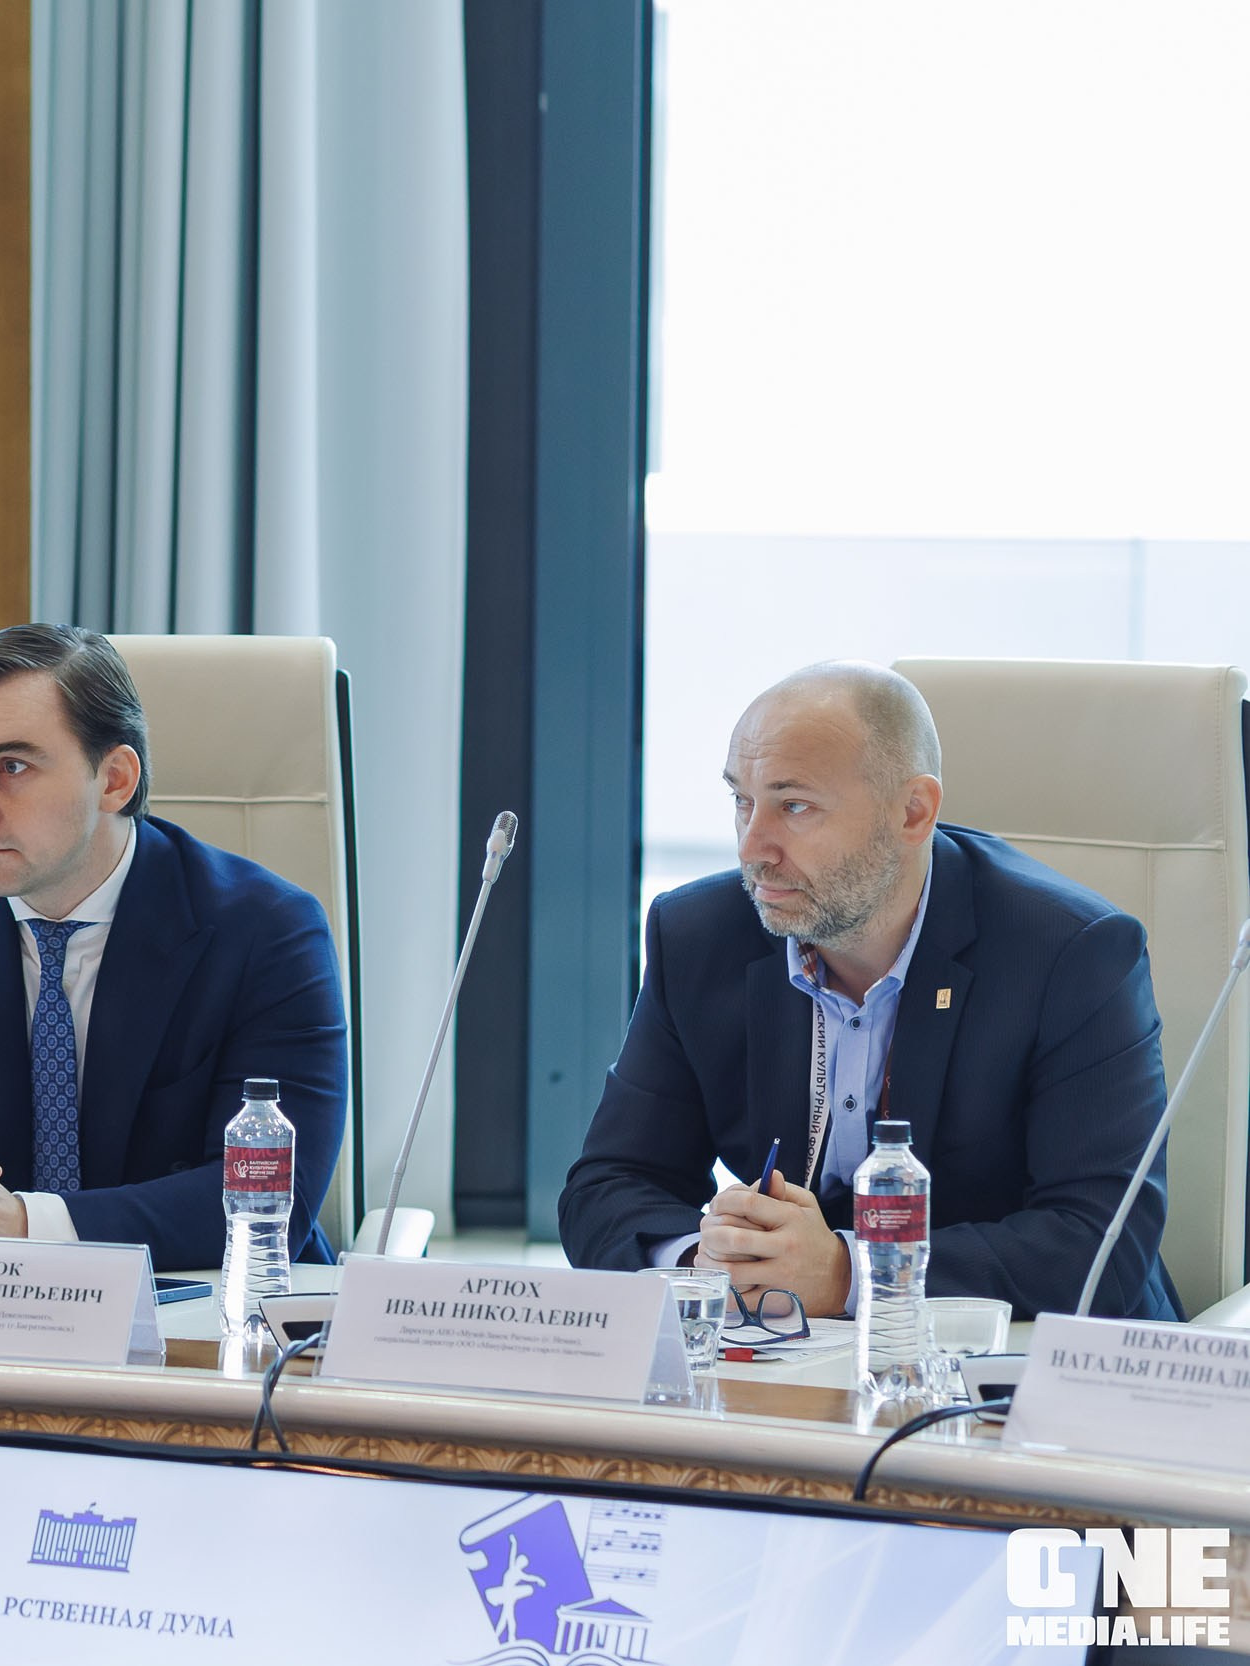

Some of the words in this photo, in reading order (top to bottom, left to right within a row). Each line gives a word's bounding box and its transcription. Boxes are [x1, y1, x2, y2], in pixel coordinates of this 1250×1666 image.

[811, 1051, 827, 1134] КУЛЬТУРНЫЙ
[460, 1277, 542, 1299] АРТЮХ
[385, 1299, 446, 1318] ИВАН
[452, 1303, 610, 1329] НИКОЛАЕВИЧ
[1122, 1329, 1250, 1360] НЕКРАСОВА
[1051, 1349, 1150, 1377] НАТАЛЬЯ
[160, 1610, 236, 1640] ДУМА
